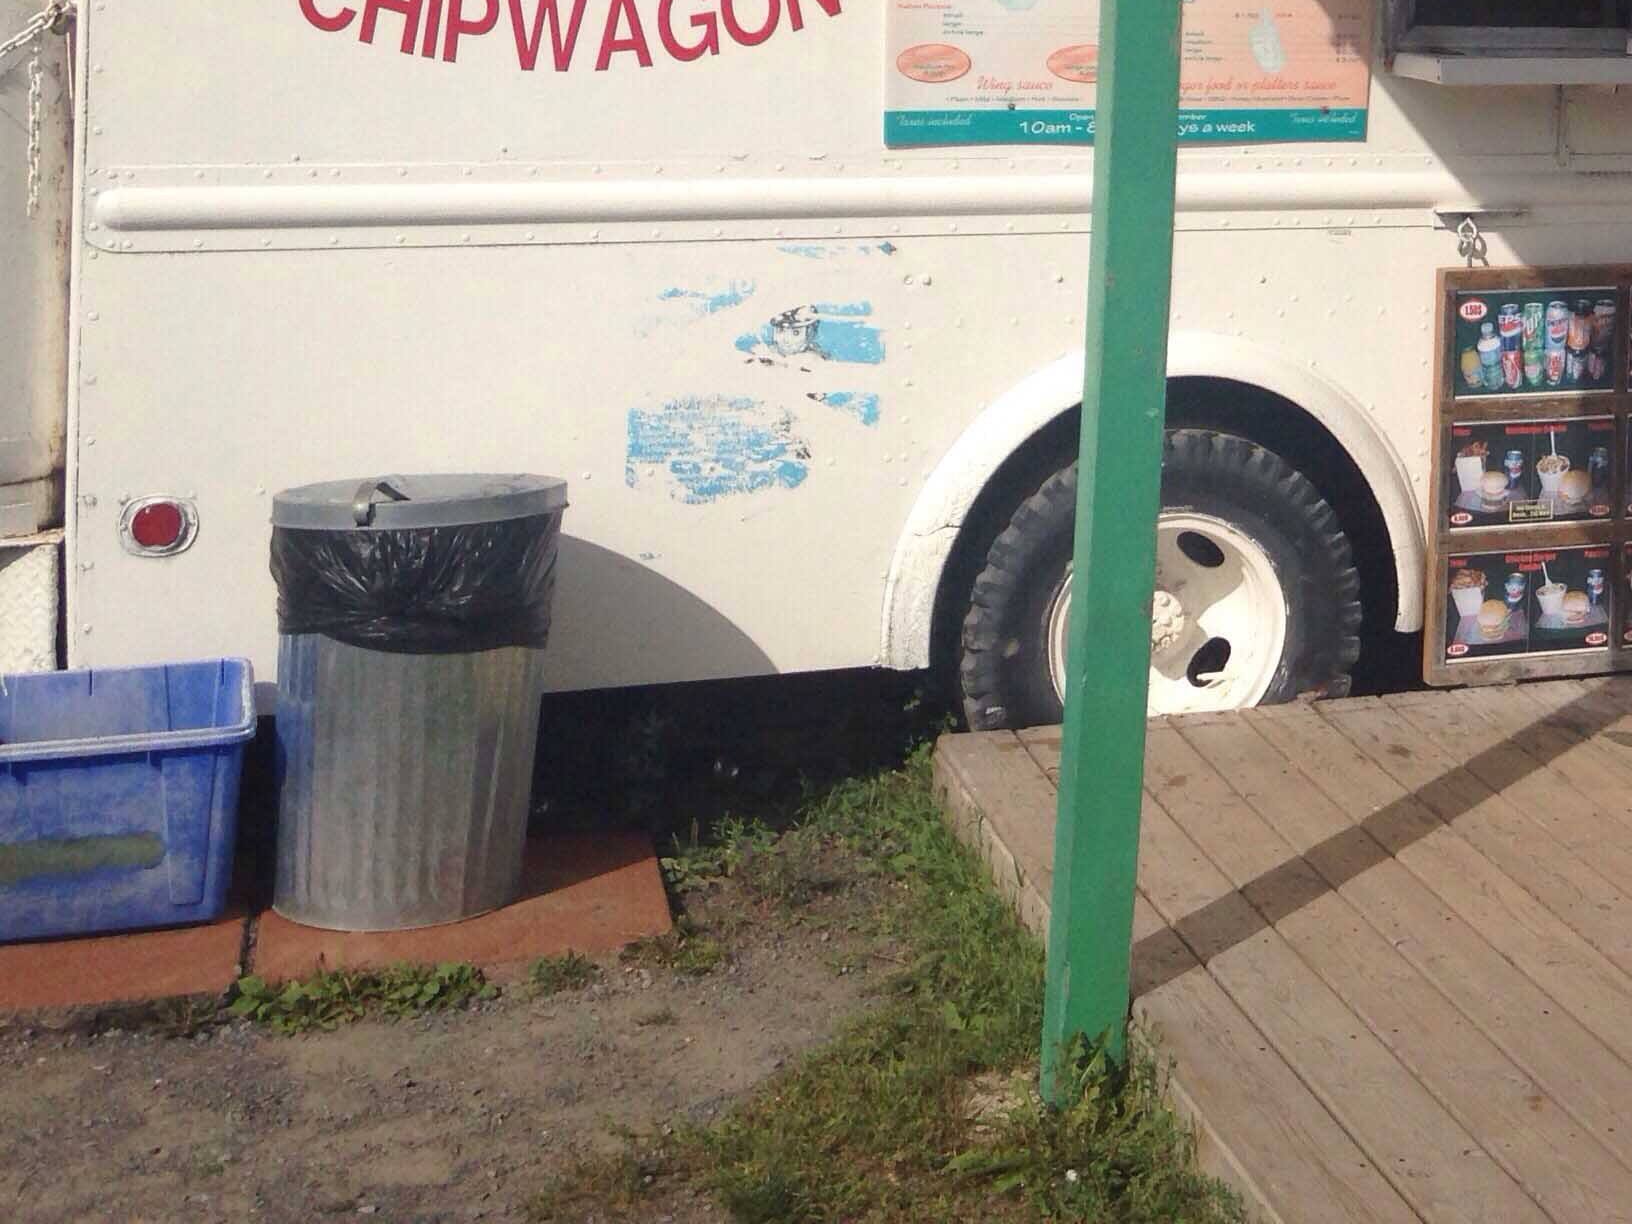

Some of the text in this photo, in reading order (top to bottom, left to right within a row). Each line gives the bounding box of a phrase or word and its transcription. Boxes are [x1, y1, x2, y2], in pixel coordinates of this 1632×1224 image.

[1019, 120, 1072, 134] 10am
[1202, 123, 1213, 133] a
[1216, 120, 1255, 133] week
